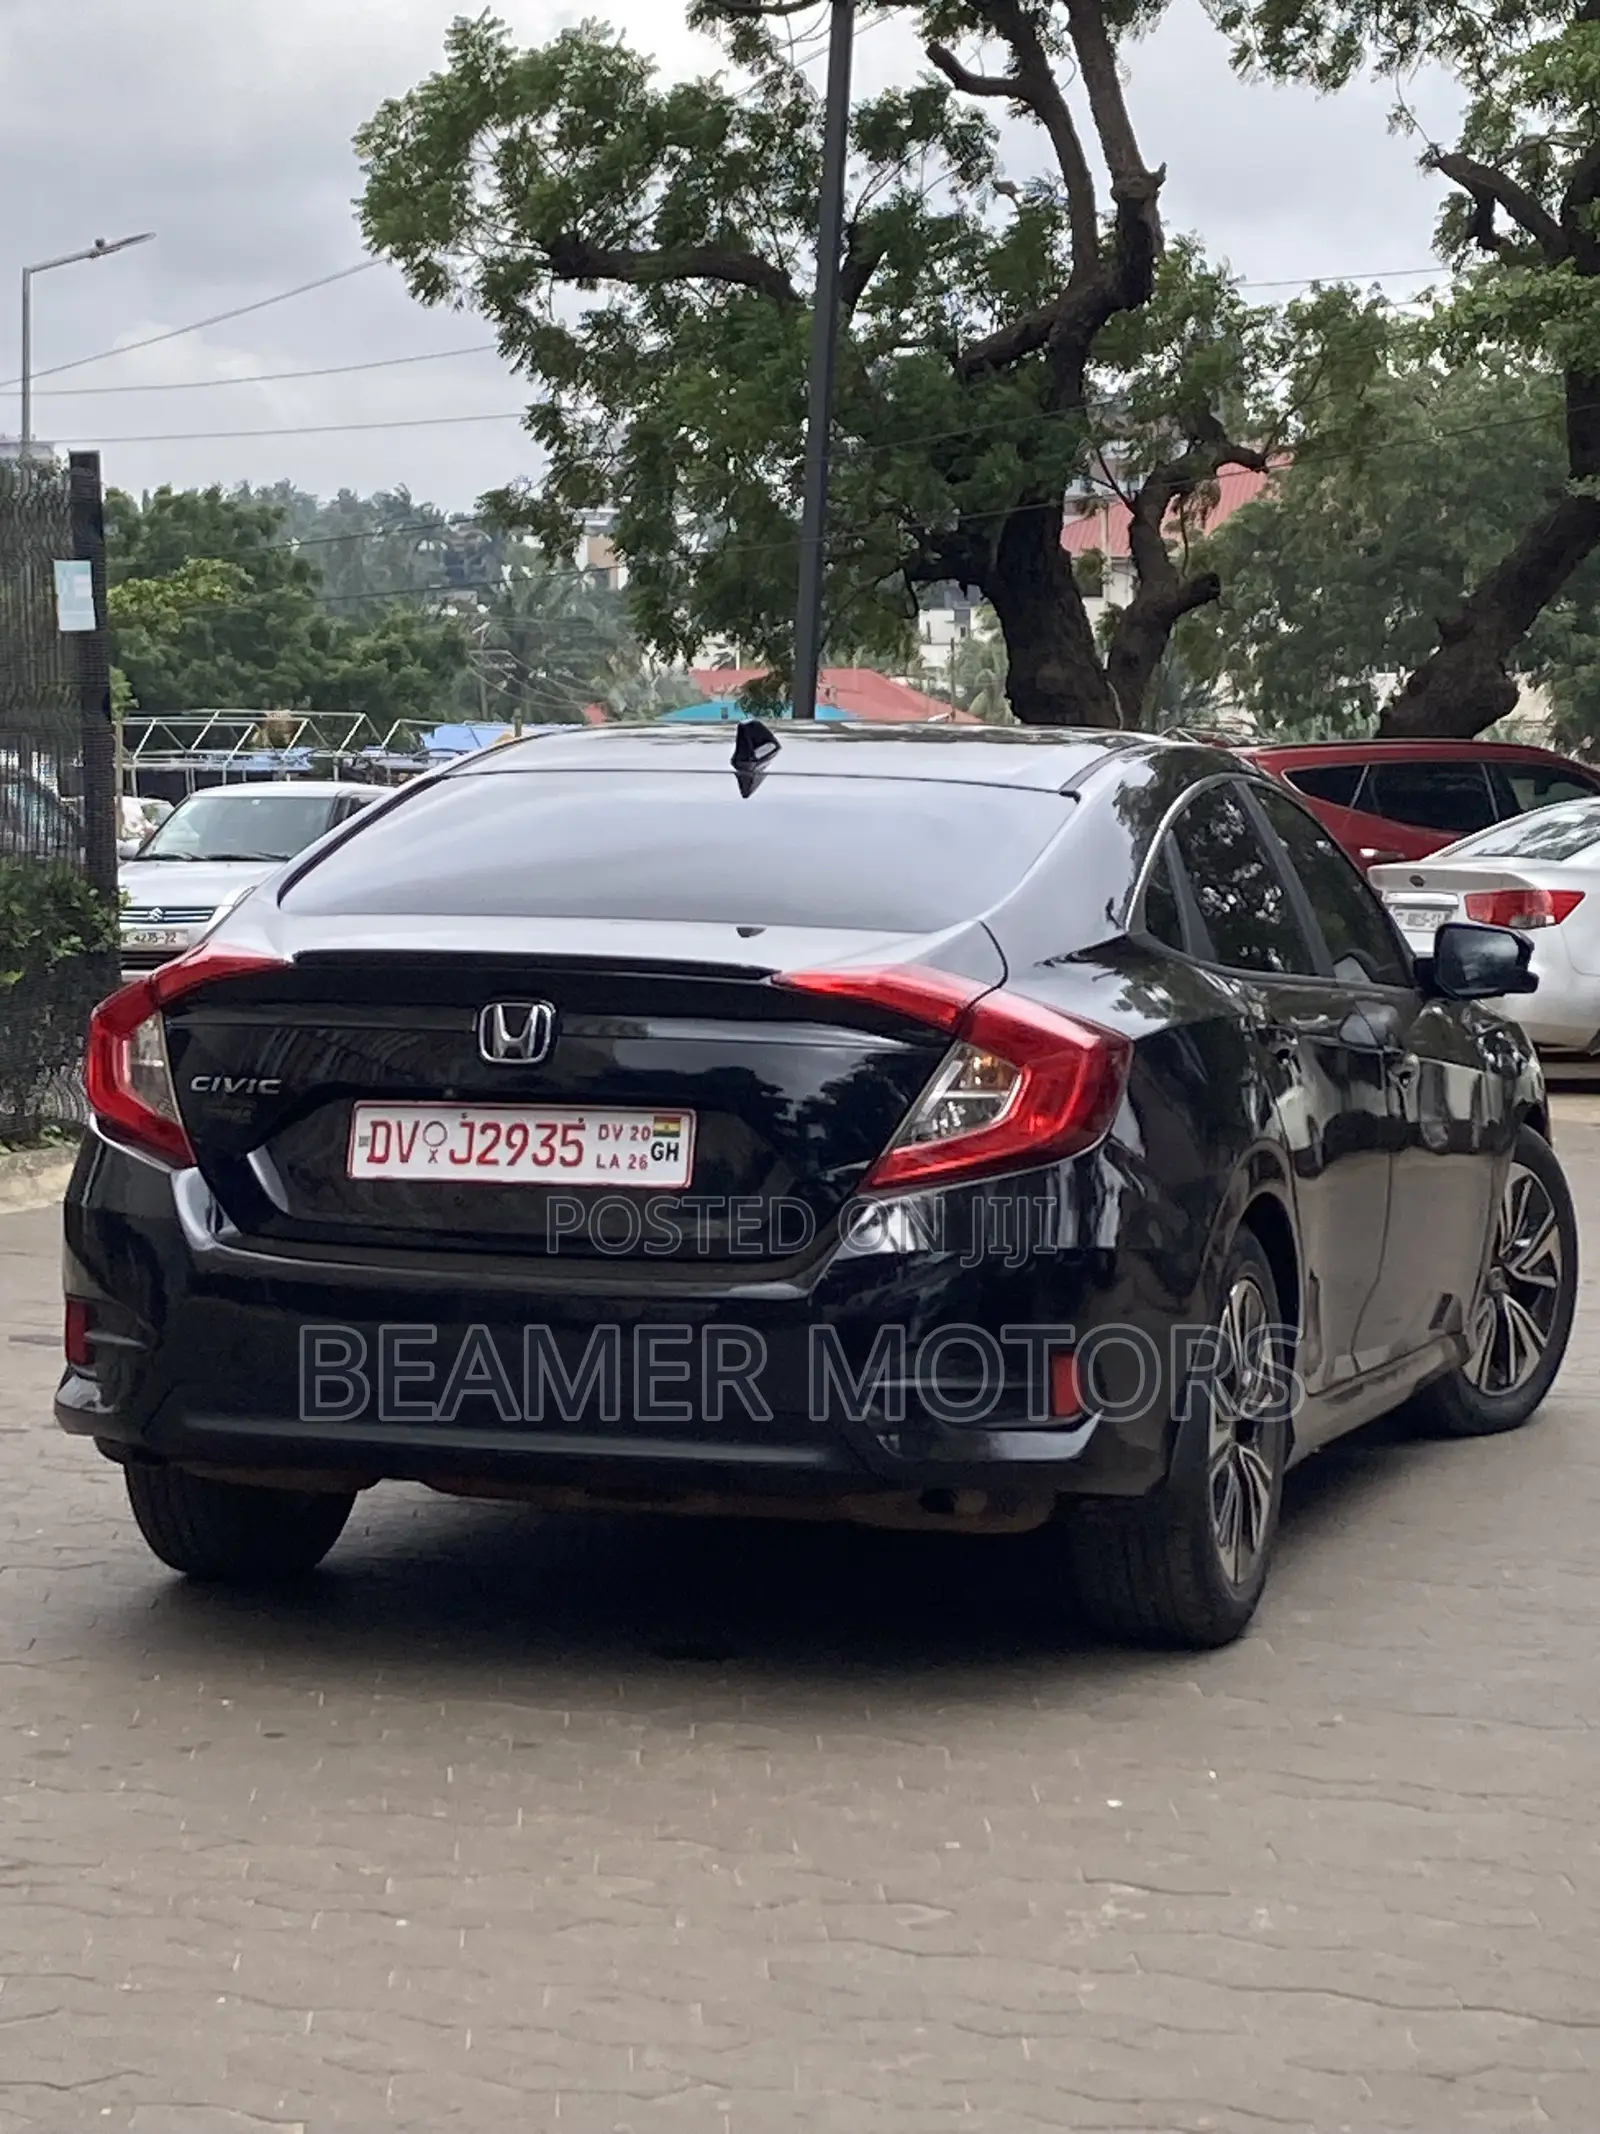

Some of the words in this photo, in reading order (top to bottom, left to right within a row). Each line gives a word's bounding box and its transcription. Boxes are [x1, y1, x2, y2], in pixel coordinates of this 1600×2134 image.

[190, 1075, 282, 1095] CIVIC
[598, 1123, 624, 1142] DV
[629, 1124, 651, 1142] 20
[366, 1119, 420, 1164] DV
[449, 1121, 586, 1167] J2935
[650, 1140, 679, 1163] GH
[596, 1153, 620, 1170] LA
[627, 1152, 649, 1171] 26
